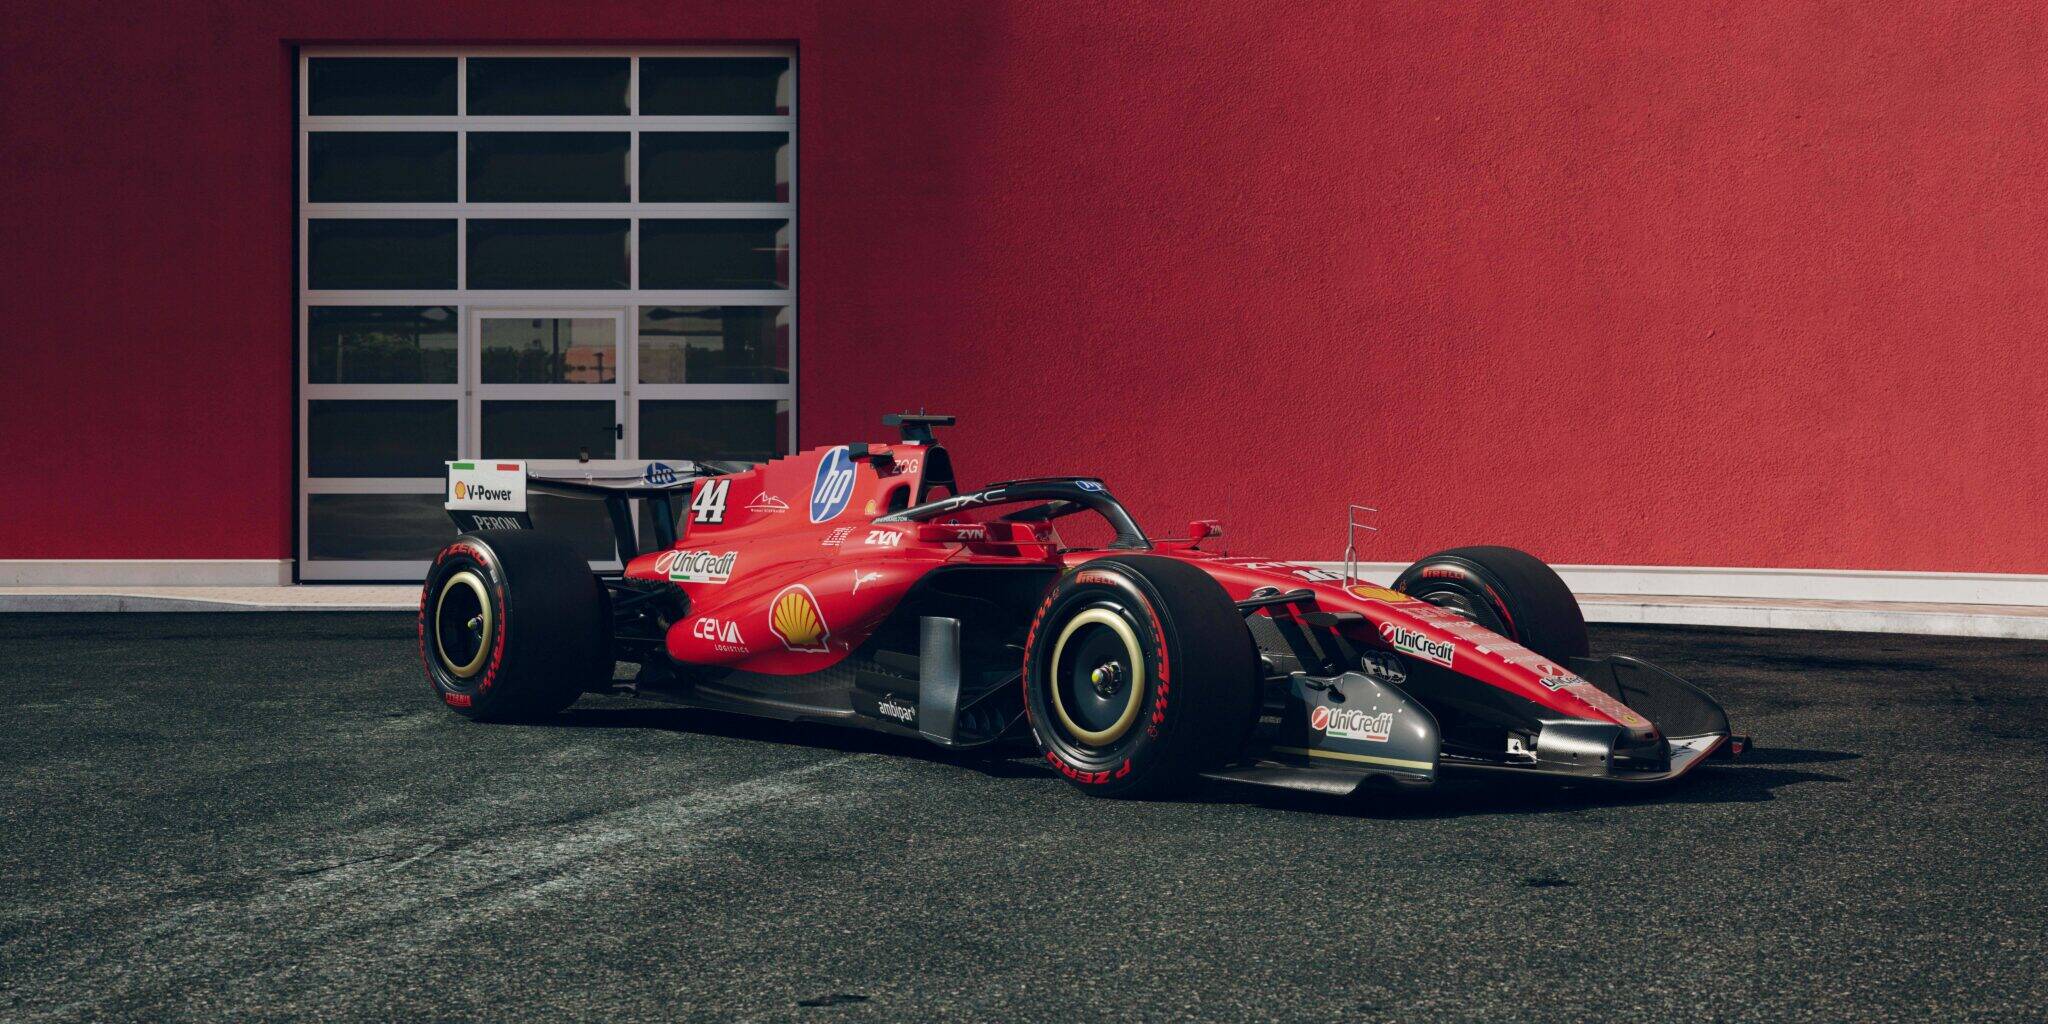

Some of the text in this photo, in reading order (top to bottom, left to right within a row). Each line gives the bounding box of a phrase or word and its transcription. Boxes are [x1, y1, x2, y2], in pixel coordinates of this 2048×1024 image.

[892, 459, 919, 474] ZCG
[466, 484, 512, 501] V-Power
[814, 447, 853, 521] hp
[691, 479, 731, 523] 44
[472, 514, 522, 530] PERONI
[864, 530, 903, 547] ZYN
[957, 528, 985, 540] ZYN
[672, 551, 736, 575] UniCredit
[1075, 570, 1120, 586] PIRELLI
[1422, 566, 1467, 580] PIRELLI
[1394, 626, 1455, 662] UniCredit
[1328, 707, 1392, 735] UniCredit
[1046, 750, 1113, 785] ZERO
